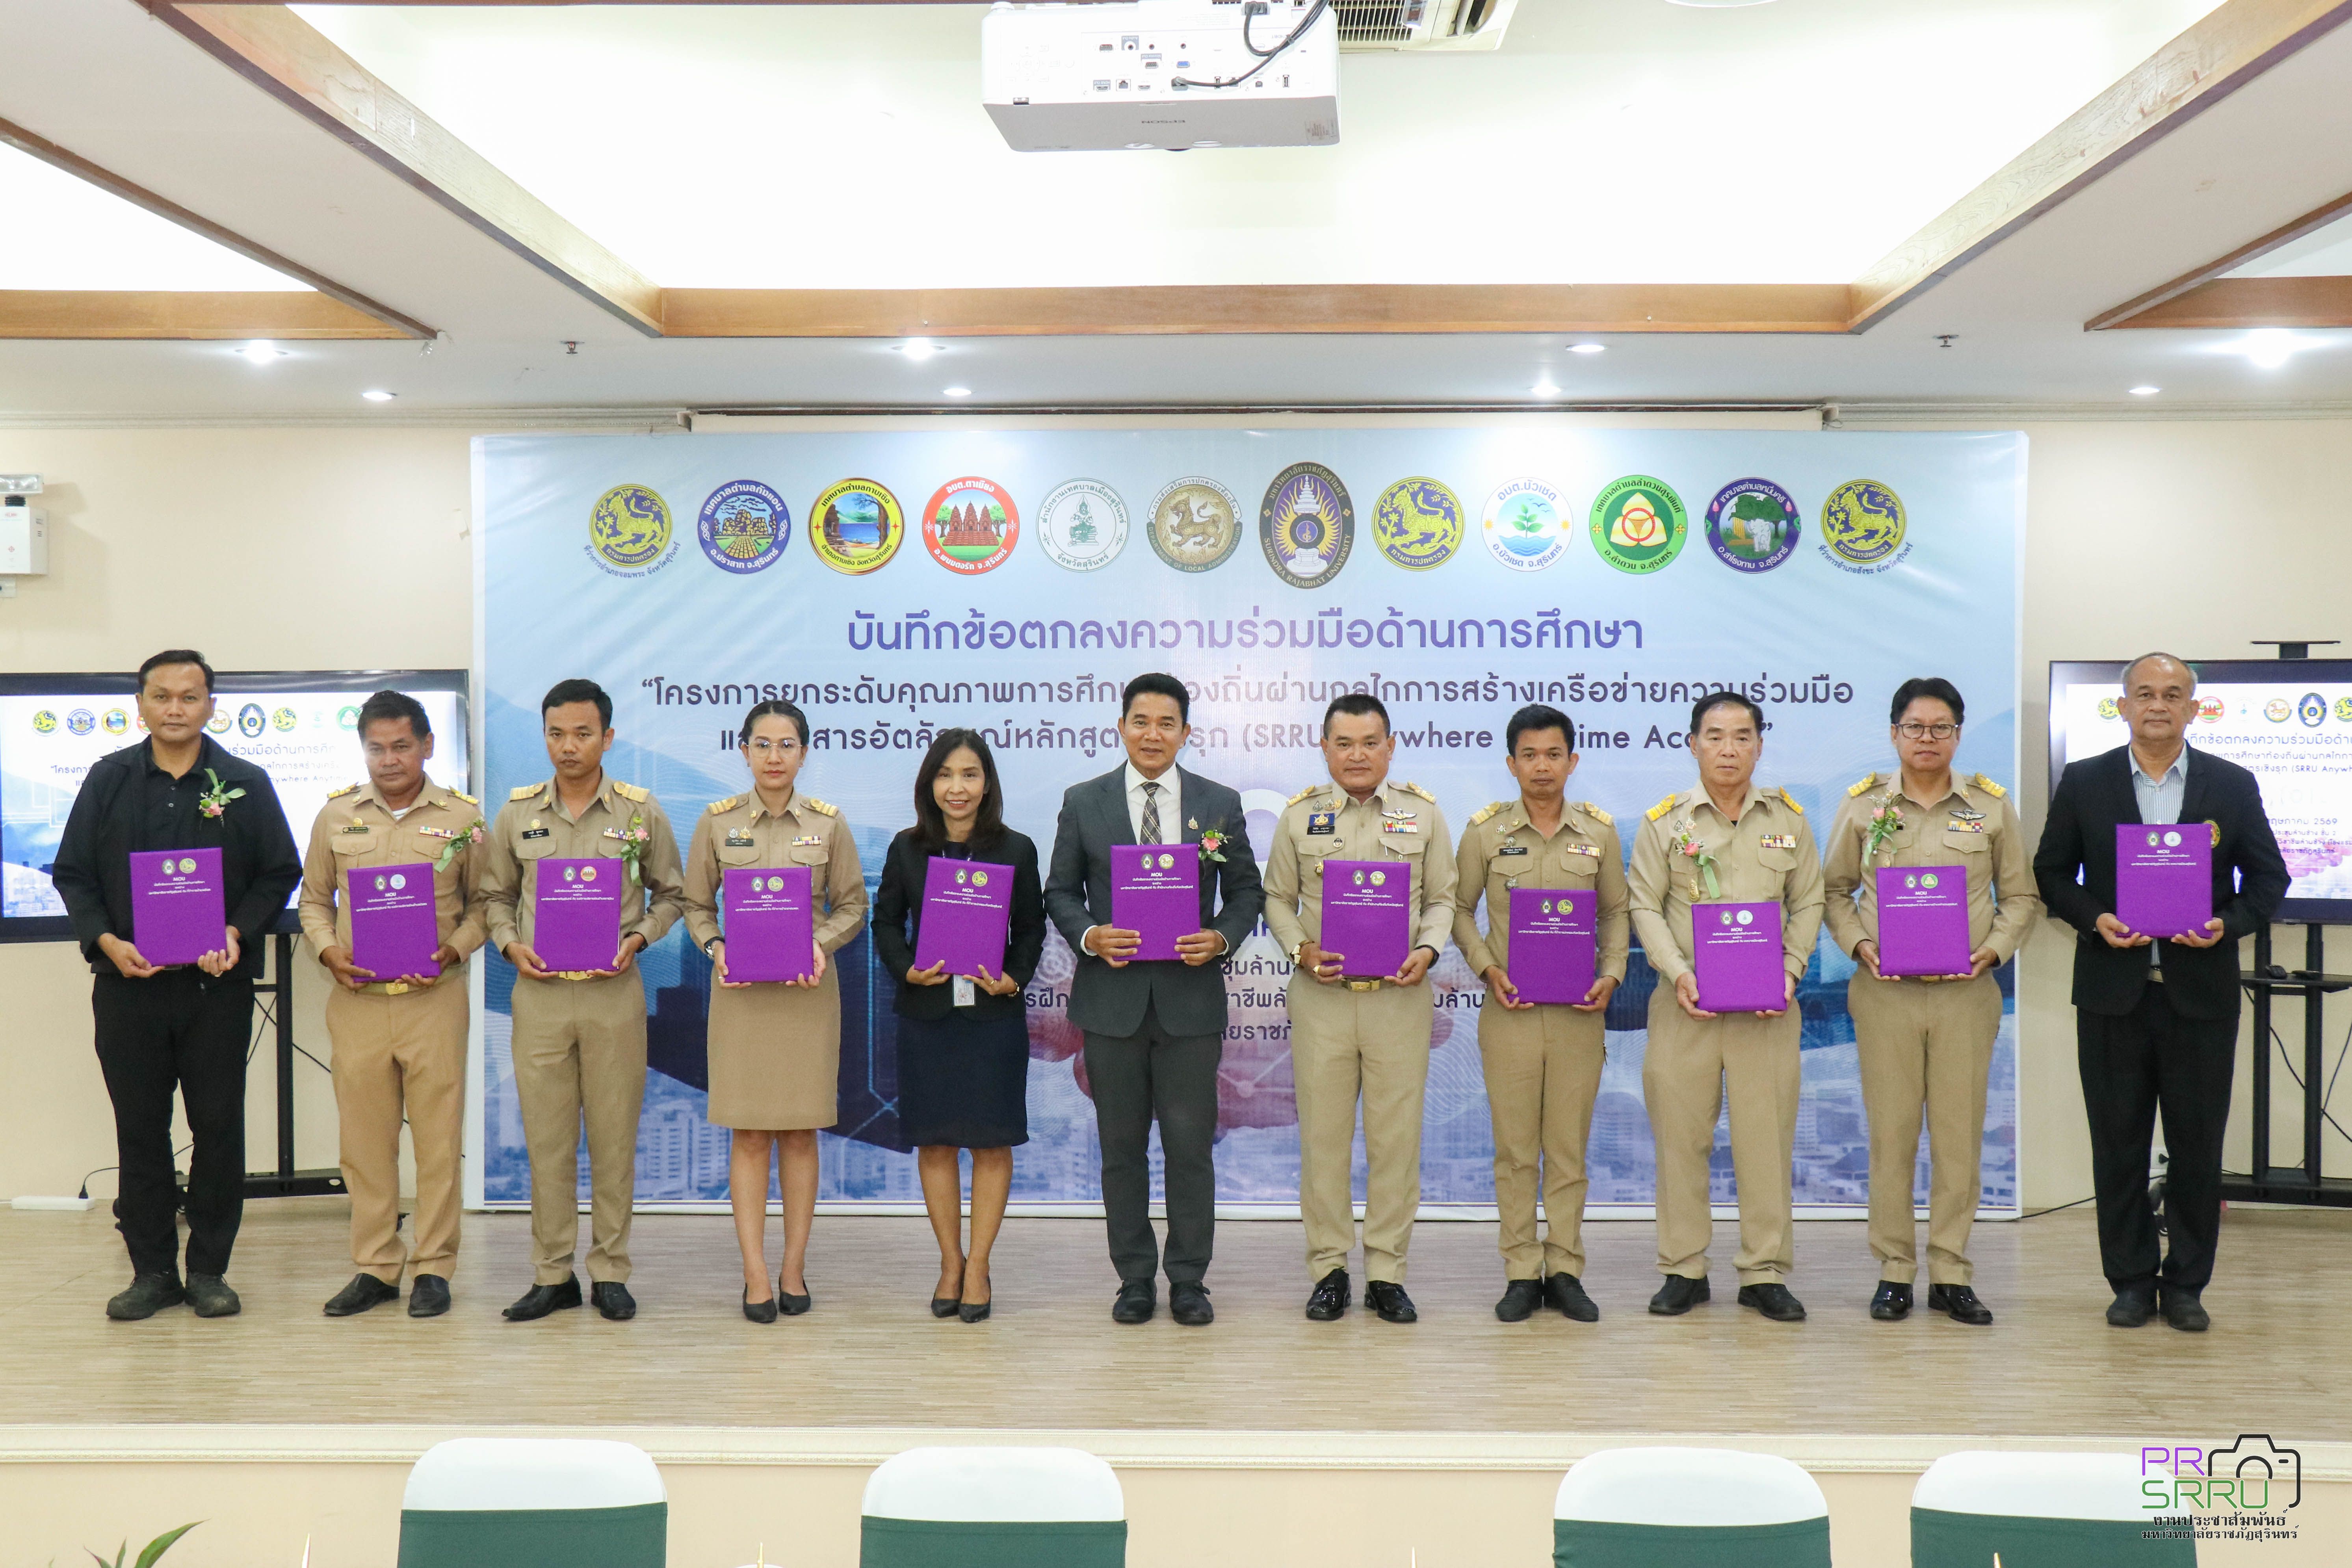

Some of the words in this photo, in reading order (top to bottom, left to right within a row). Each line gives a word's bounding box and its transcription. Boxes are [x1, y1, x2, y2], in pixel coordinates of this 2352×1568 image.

[1497, 479, 1557, 502] อบต.บัวเชด
[1148, 526, 1172, 565] DEPARTMENT
[1208, 525, 1241, 568] ADMINISTRATION
[1264, 537, 1286, 578] SURINDRA
[1286, 575, 1325, 587] RAJABHAT
[1327, 533, 1352, 578] UNIVERSITY
[848, 606, 1643, 650] บันทึกข้อตกลงความร่วมมือด้านการศึกษา
[1393, 721, 1493, 748] where
[2322, 765, 2352, 774] Anywh
[2268, 818, 2309, 826] ฤษภาคม
